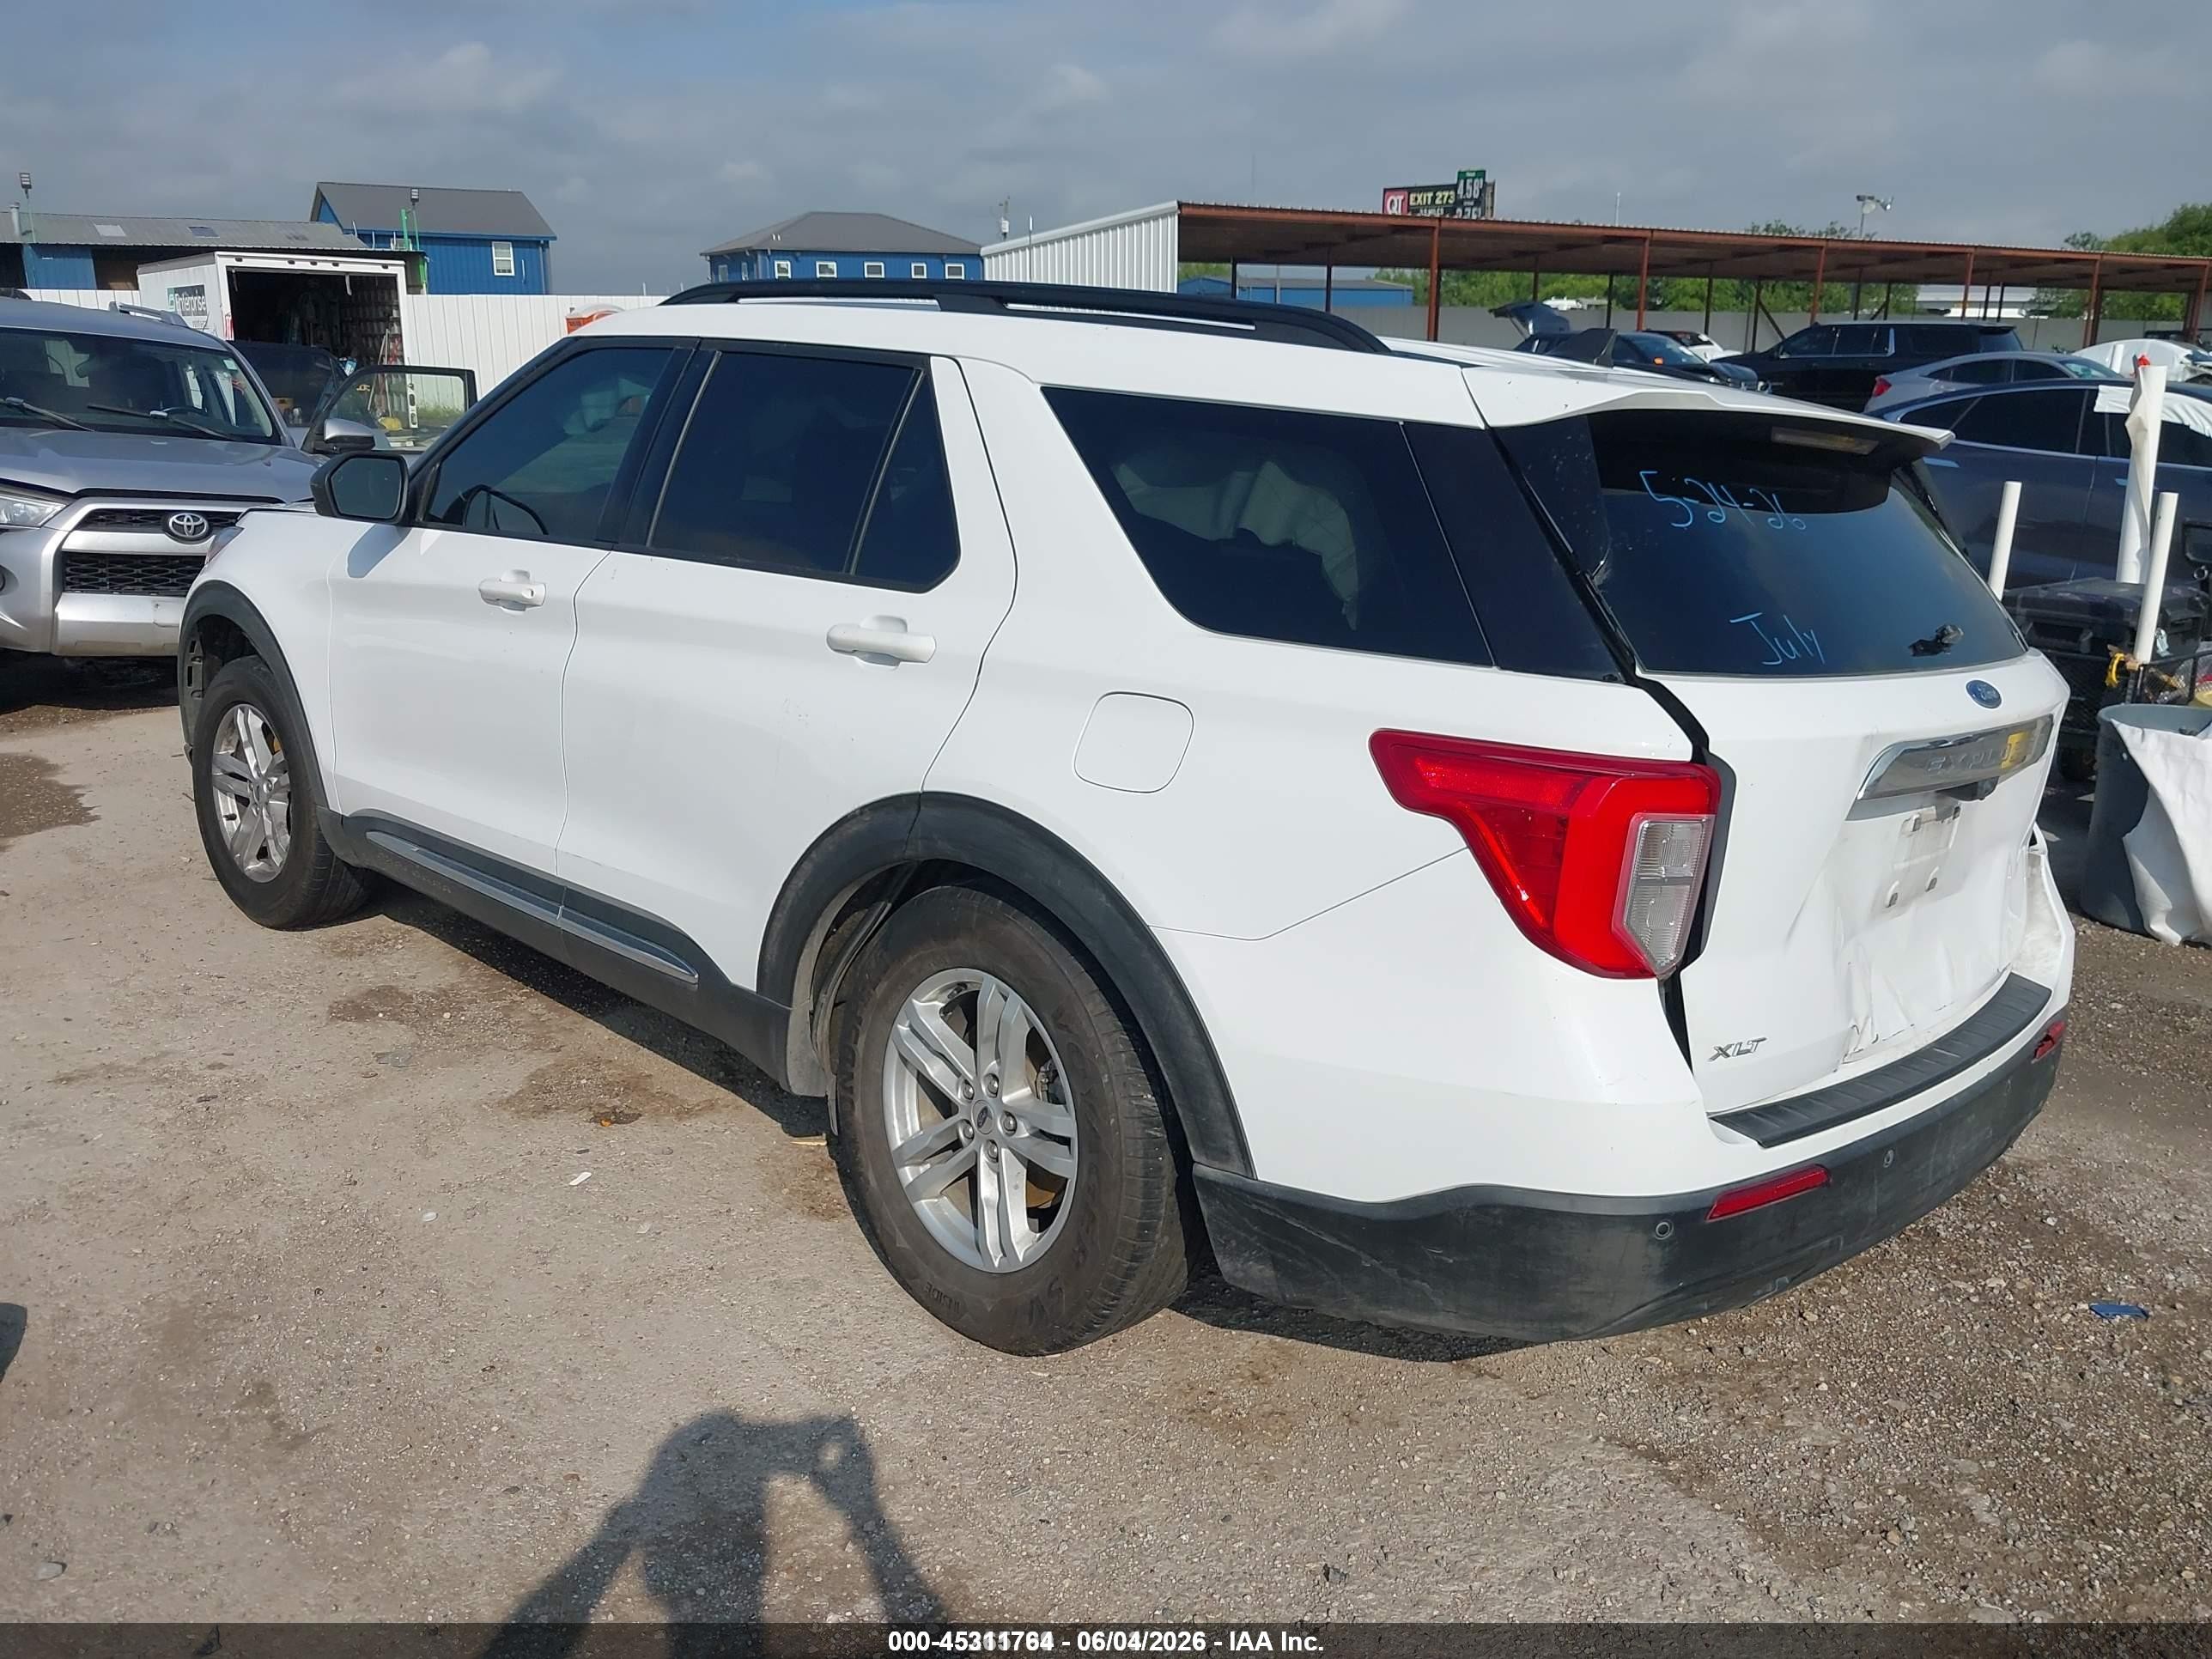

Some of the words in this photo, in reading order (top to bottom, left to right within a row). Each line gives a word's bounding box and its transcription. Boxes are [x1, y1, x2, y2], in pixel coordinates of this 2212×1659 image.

[1387, 195, 1404, 216] QT
[1409, 191, 1434, 206] EXIT
[1435, 190, 1455, 204] 273
[1729, 611, 1826, 665] July
[1708, 1037, 1767, 1062] XLT
